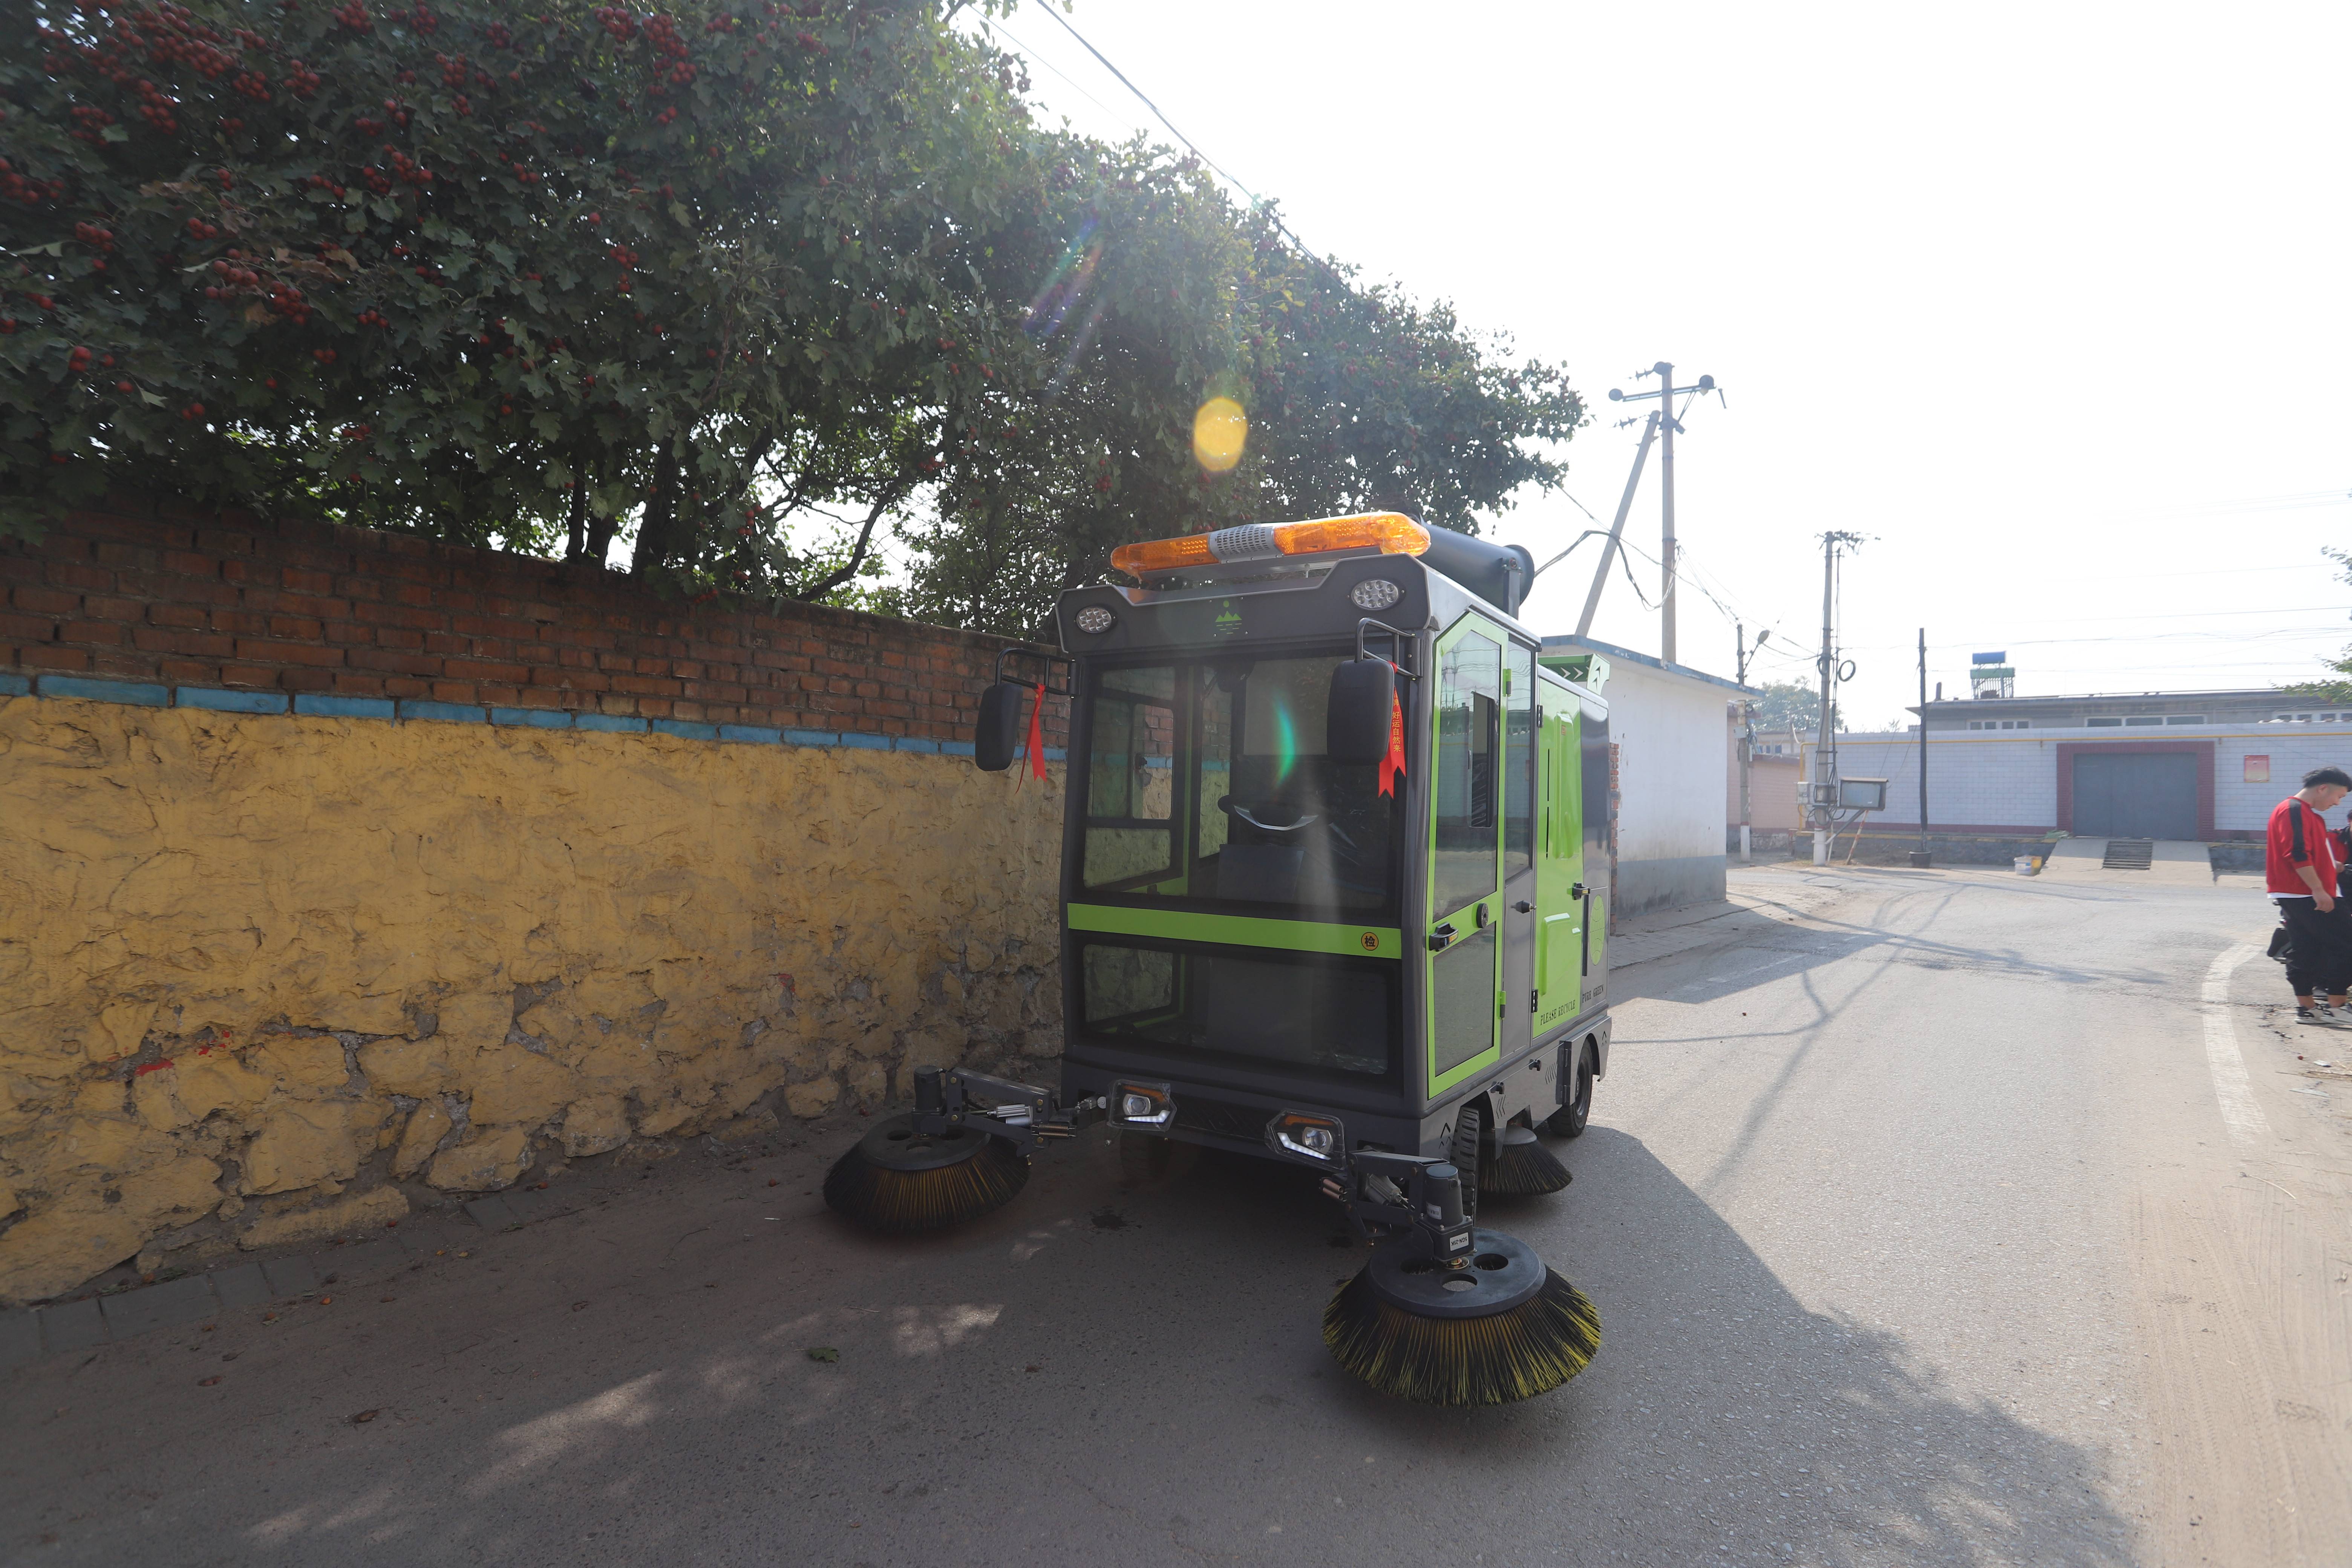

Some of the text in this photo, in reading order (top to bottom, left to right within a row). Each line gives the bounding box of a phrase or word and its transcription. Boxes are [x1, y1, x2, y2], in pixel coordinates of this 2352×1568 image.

[1392, 711, 1401, 752] 好运自然来
[1364, 936, 1375, 947] 检
[1582, 984, 1604, 1003] PURE GREEN
[1540, 1000, 1575, 1025] PLEASE RECYCLE
[1451, 1237, 1467, 1246] 5GN-25K
